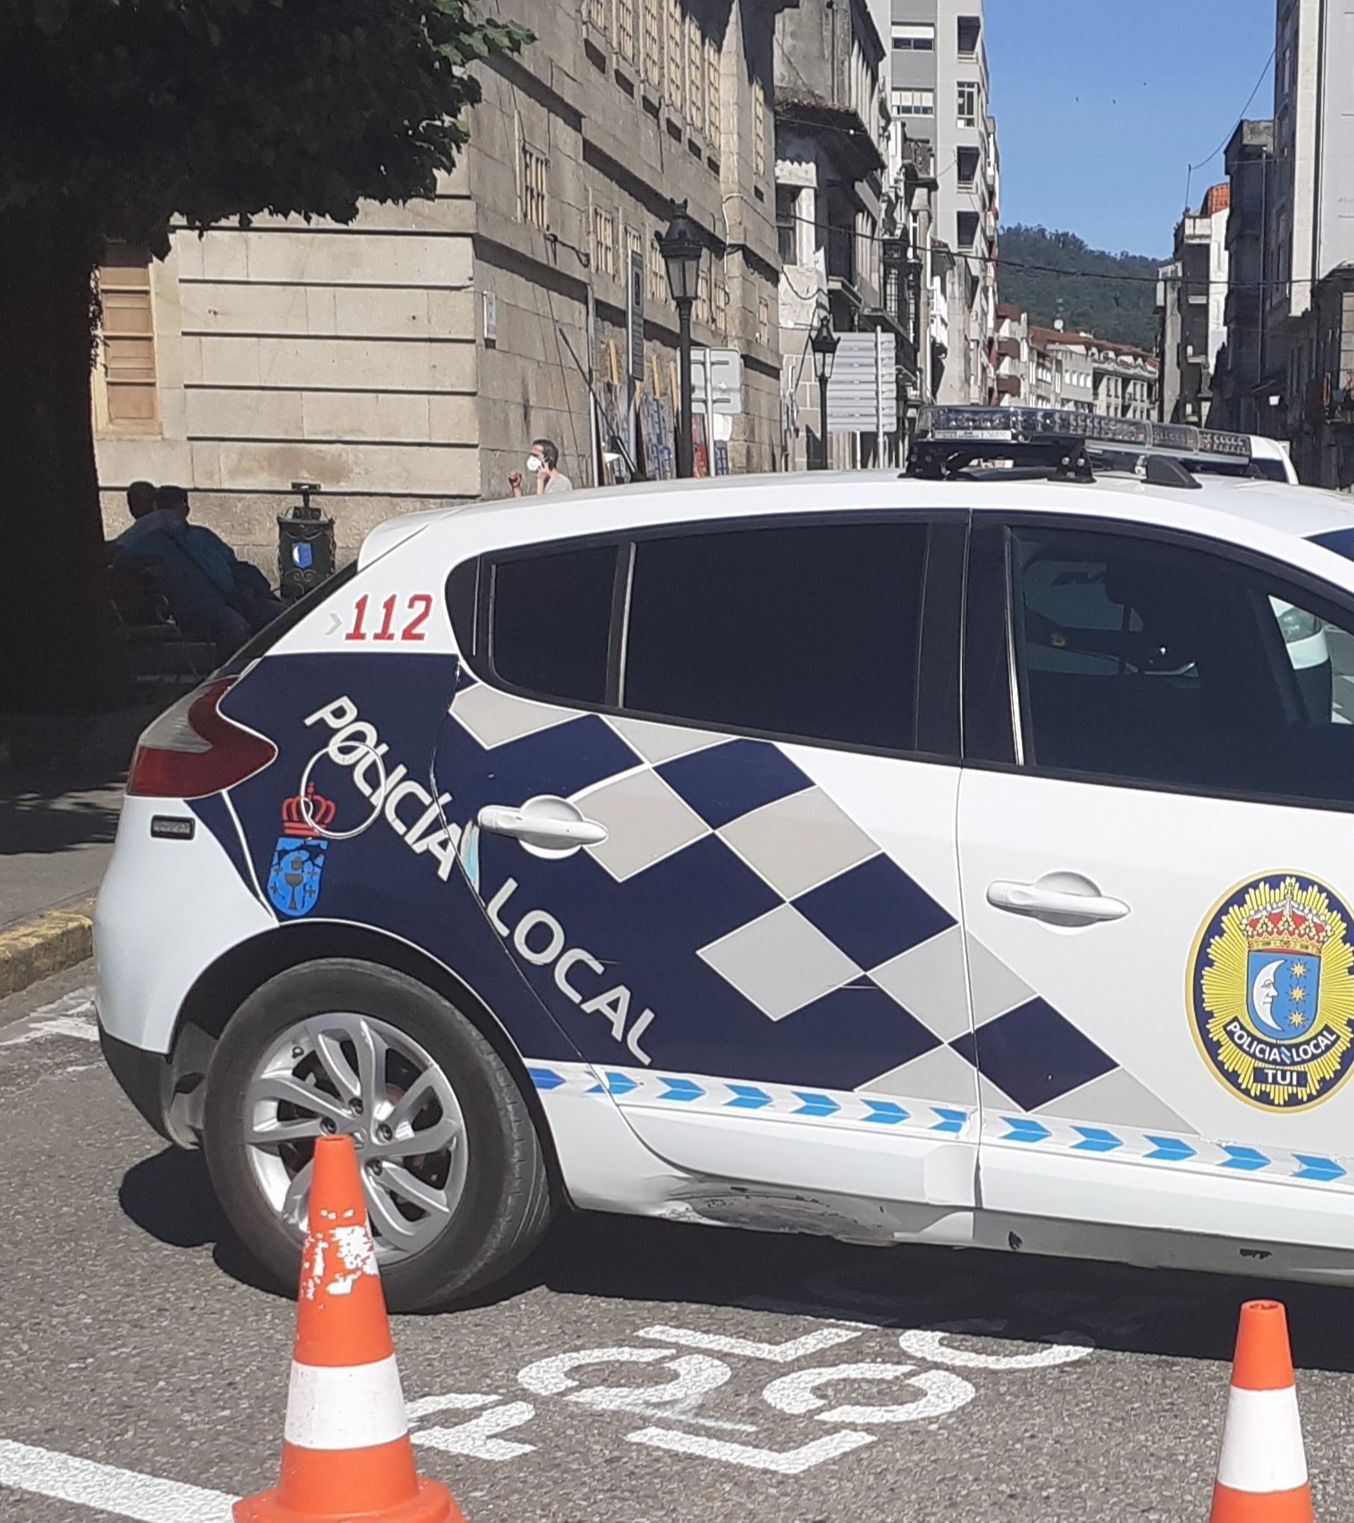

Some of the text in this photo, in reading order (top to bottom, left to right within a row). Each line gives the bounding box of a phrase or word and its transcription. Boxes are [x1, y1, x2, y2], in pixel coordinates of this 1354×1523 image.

[345, 593, 433, 641] 112
[486, 877, 655, 1066] LOCAL
[1226, 1021, 1337, 1062] POLICIA LOCAL
[1264, 1069, 1297, 1085] TUI
